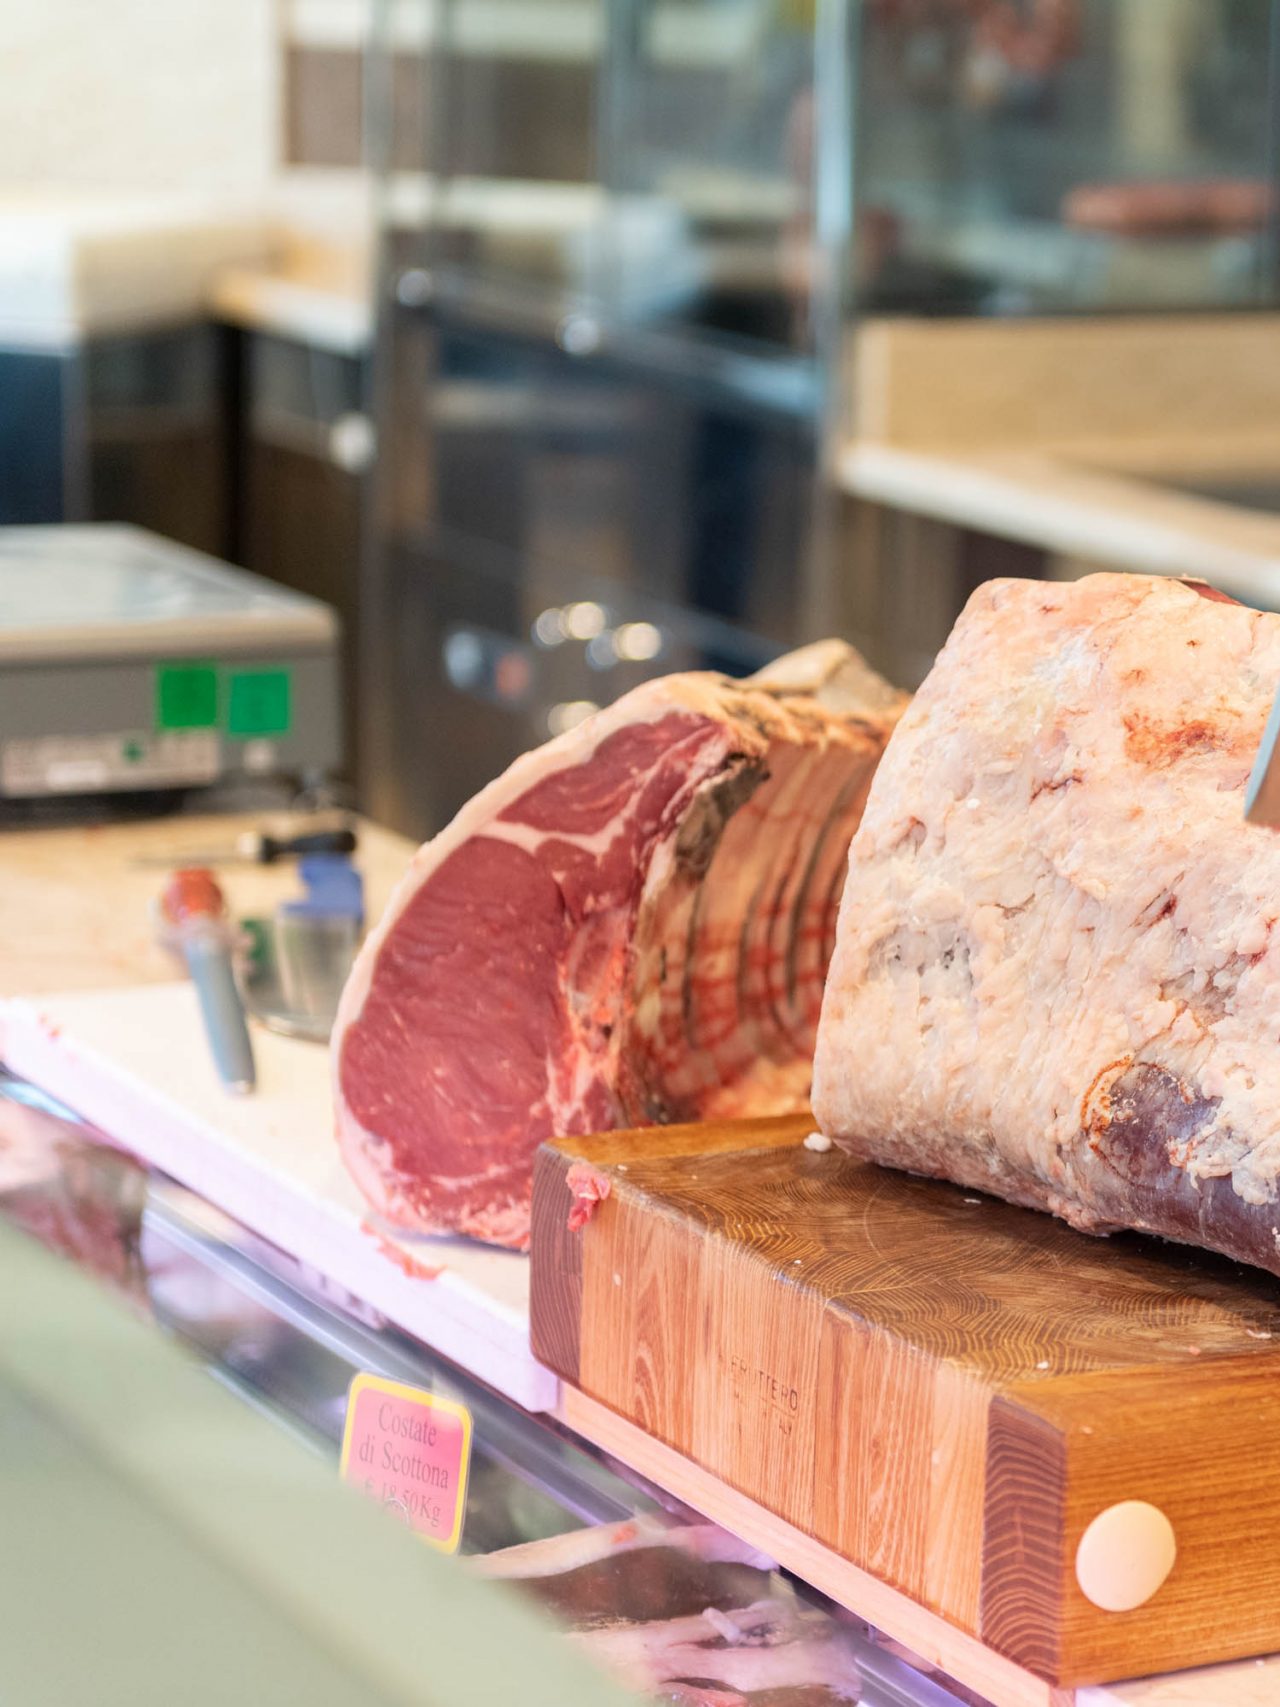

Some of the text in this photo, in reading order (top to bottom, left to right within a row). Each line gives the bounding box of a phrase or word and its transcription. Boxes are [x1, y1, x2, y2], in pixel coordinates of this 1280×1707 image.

[379, 1402, 438, 1447] Costate
[359, 1434, 449, 1490] di Scottona
